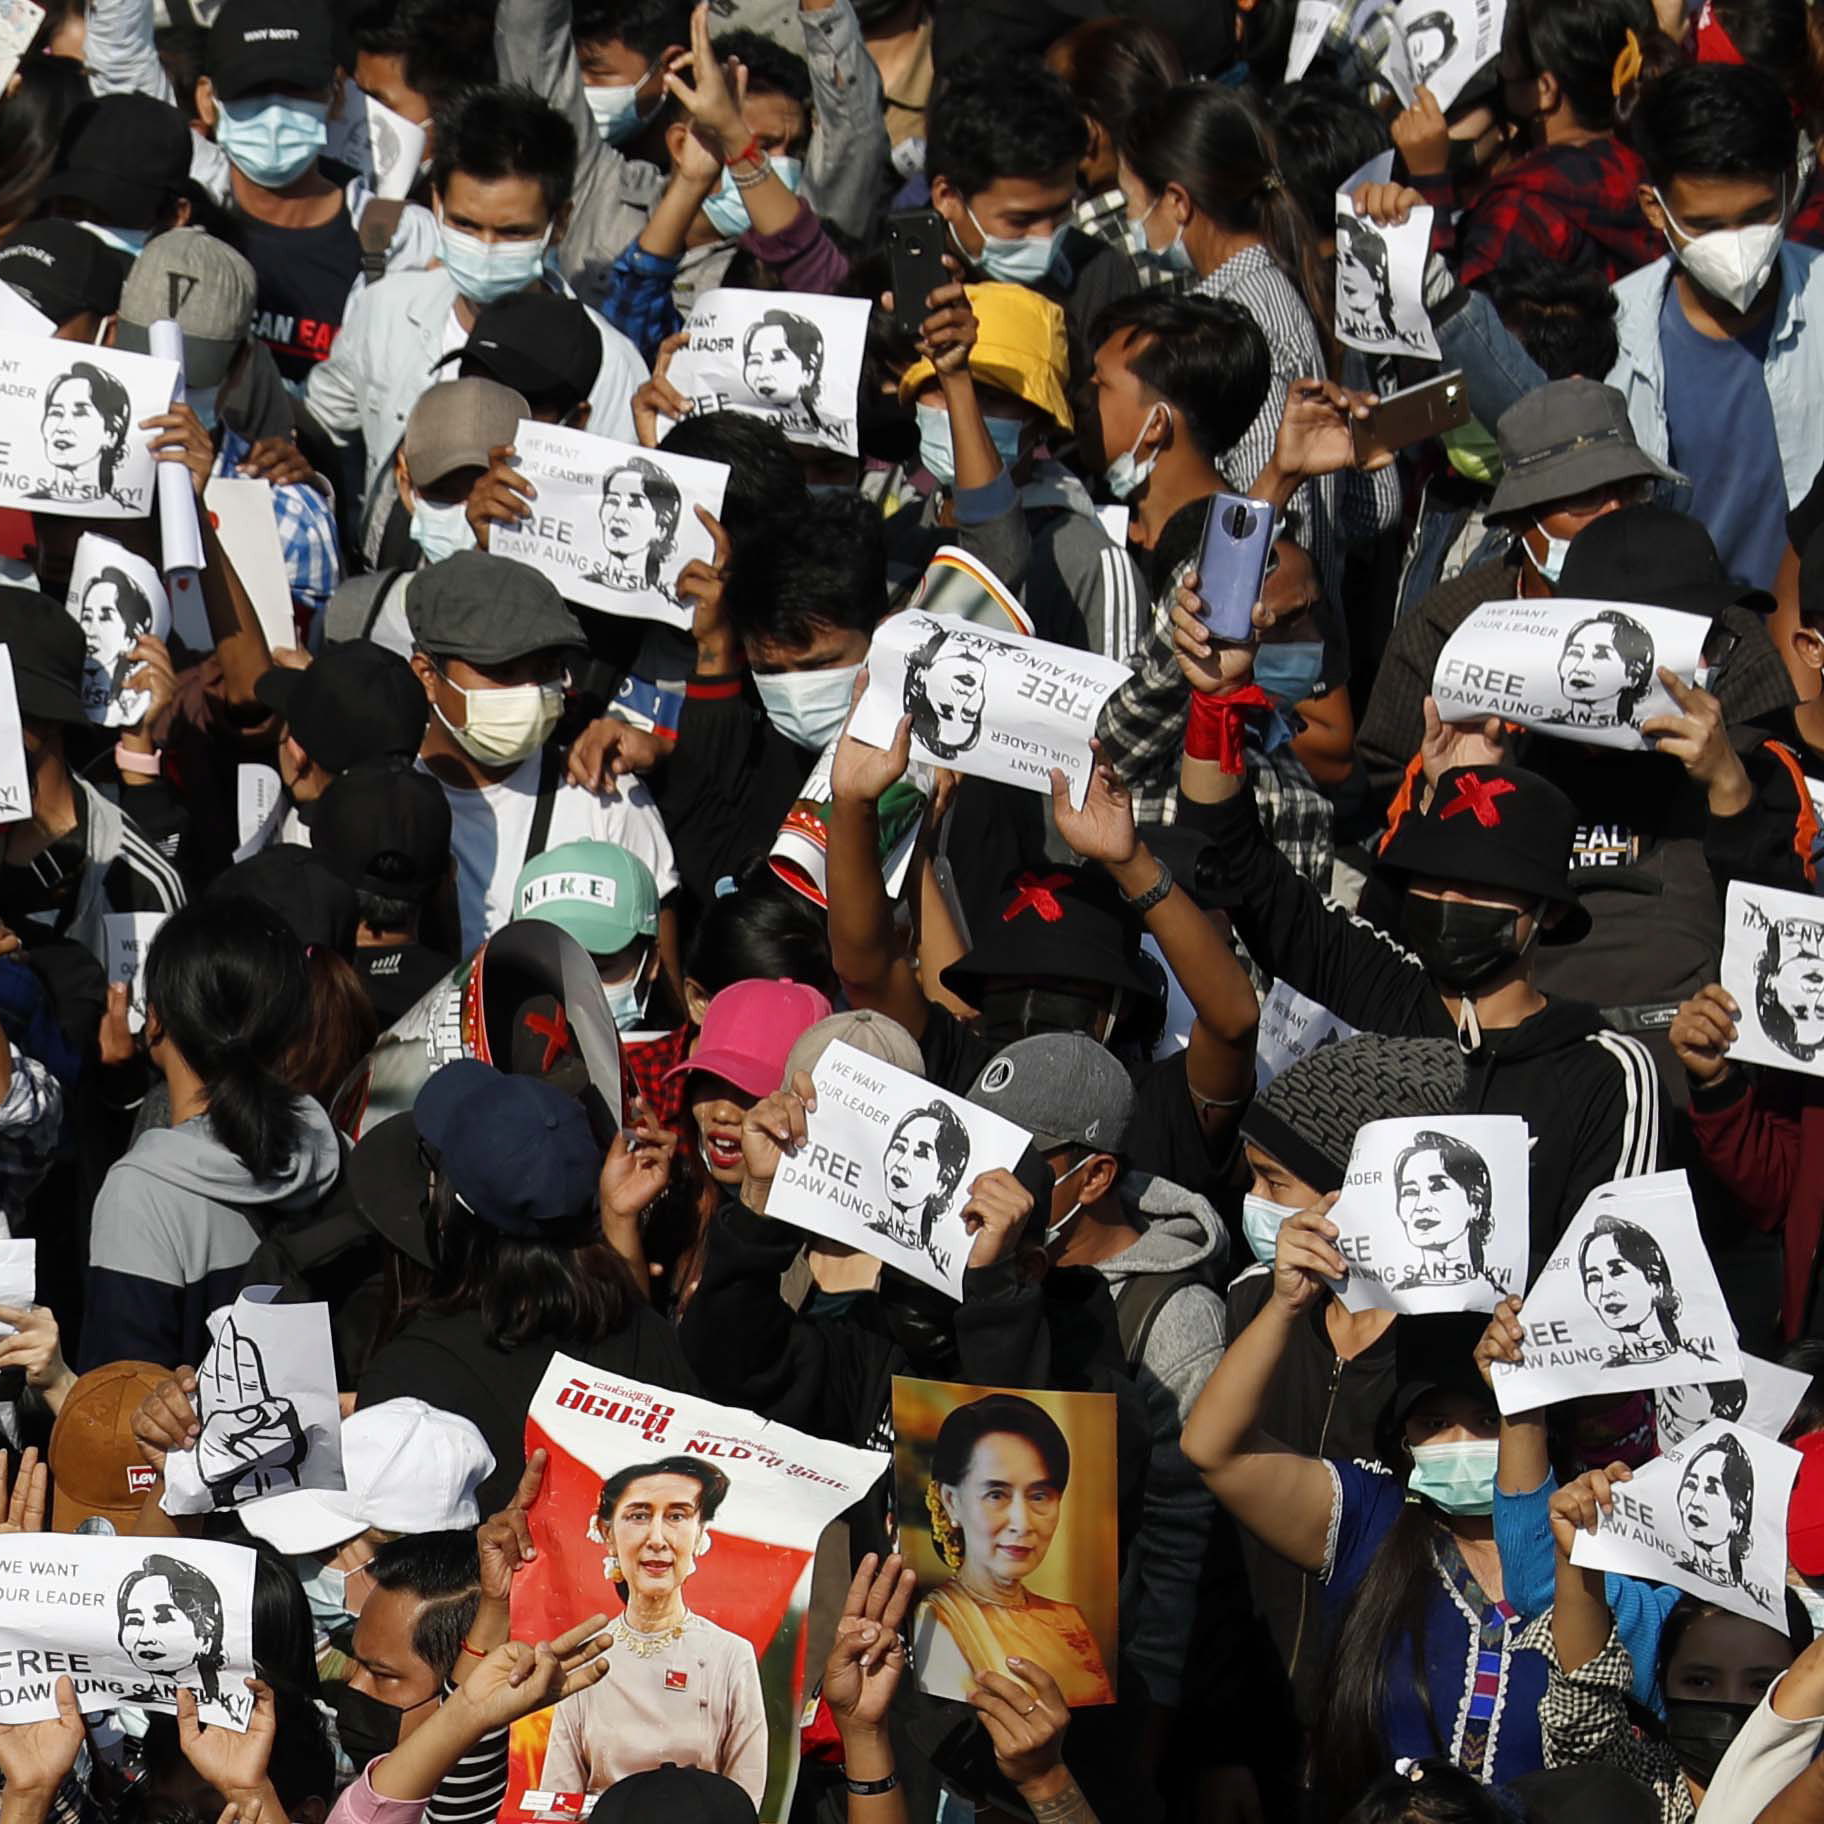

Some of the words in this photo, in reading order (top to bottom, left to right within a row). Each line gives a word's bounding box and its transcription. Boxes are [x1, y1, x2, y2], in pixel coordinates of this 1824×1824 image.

[1444, 661, 1527, 699] FREE
[1484, 695, 1545, 720] AUNG
[28, 1563, 80, 1579] WANT
[35, 1589, 106, 1609] LEADER
